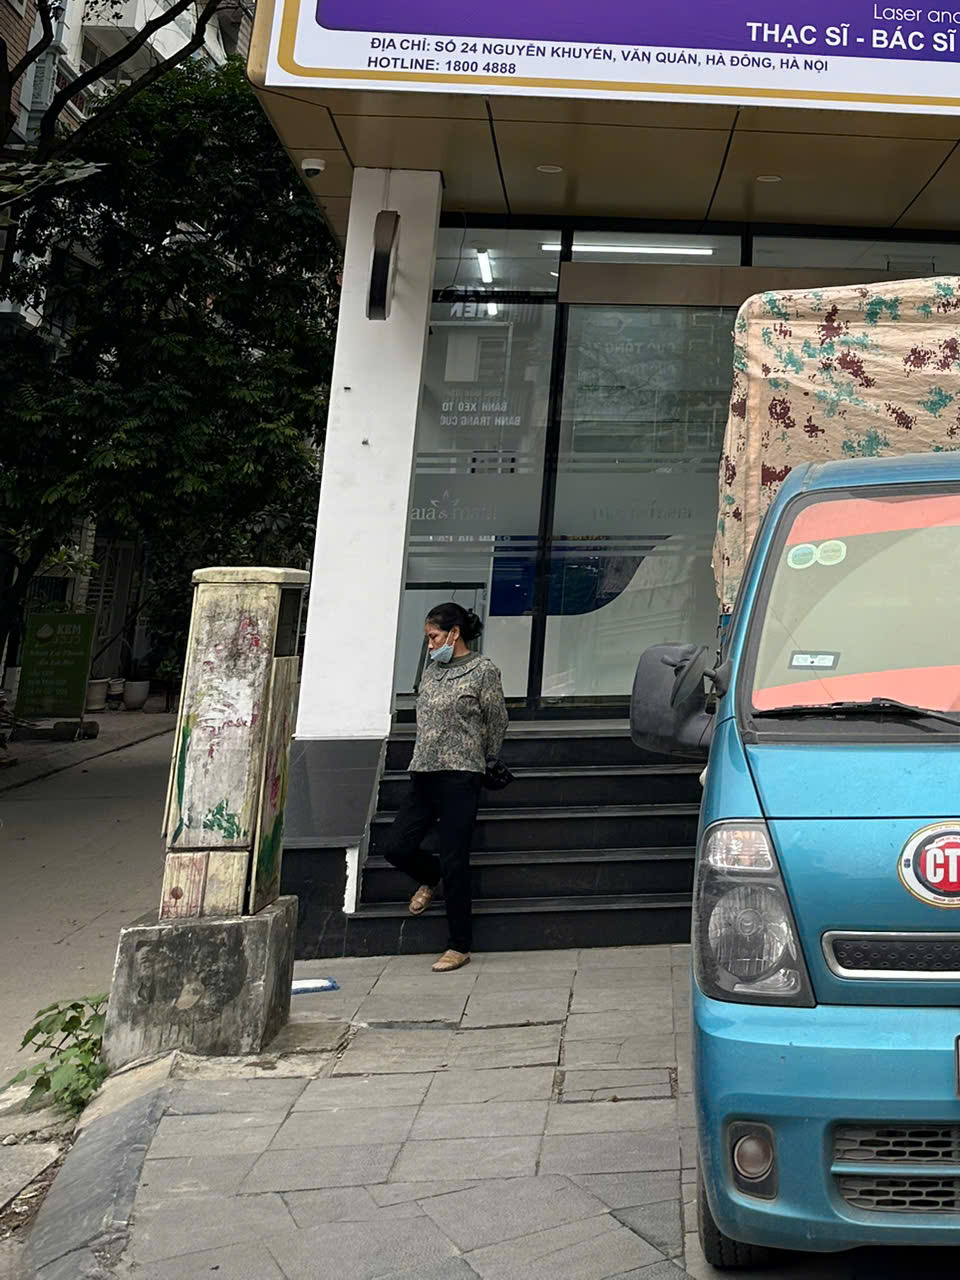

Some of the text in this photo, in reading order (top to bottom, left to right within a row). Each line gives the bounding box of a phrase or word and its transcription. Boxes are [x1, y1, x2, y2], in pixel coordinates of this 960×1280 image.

[873, 3, 922, 22] Laser
[746, 21, 818, 49] THẠC
[825, 23, 851, 47] SĨ
[872, 25, 925, 51] BÁC
[932, 29, 957, 52] SĨ
[367, 56, 517, 74] HOTLINE: 1800 4888
[370, 37, 829, 74] ĐỊA CHỈ: SỐ 24 NGUYỄN KHUYẾN, VĂN QUÁN, HÀ ĐÔNG, HÀ NỘI
